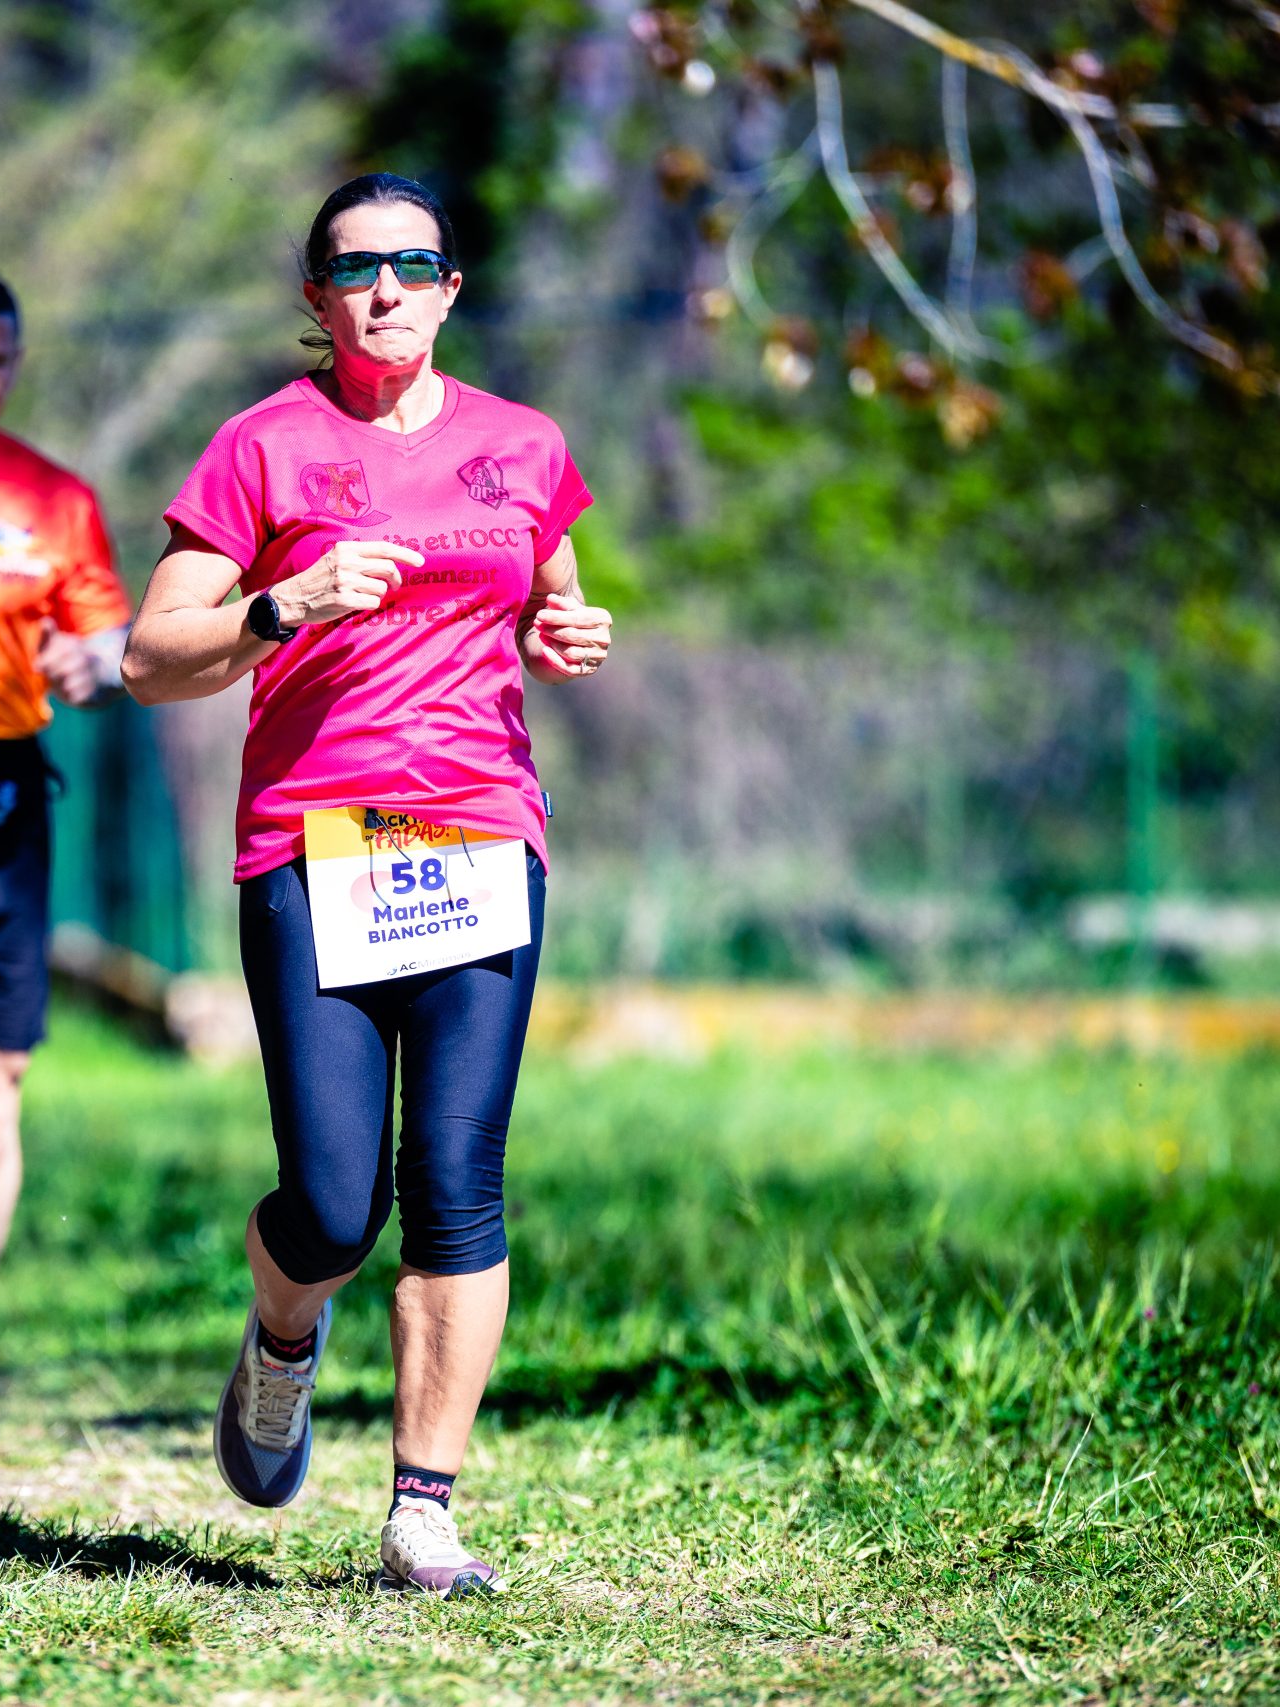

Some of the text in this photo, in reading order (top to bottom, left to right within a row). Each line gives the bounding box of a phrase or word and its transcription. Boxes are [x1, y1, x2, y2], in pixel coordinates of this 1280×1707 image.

[424, 533, 451, 550] et
[453, 528, 519, 549] l'OCC
[391, 858, 446, 895] 58
[372, 897, 469, 924] Marlene
[368, 914, 479, 944] BIANCOTTO
